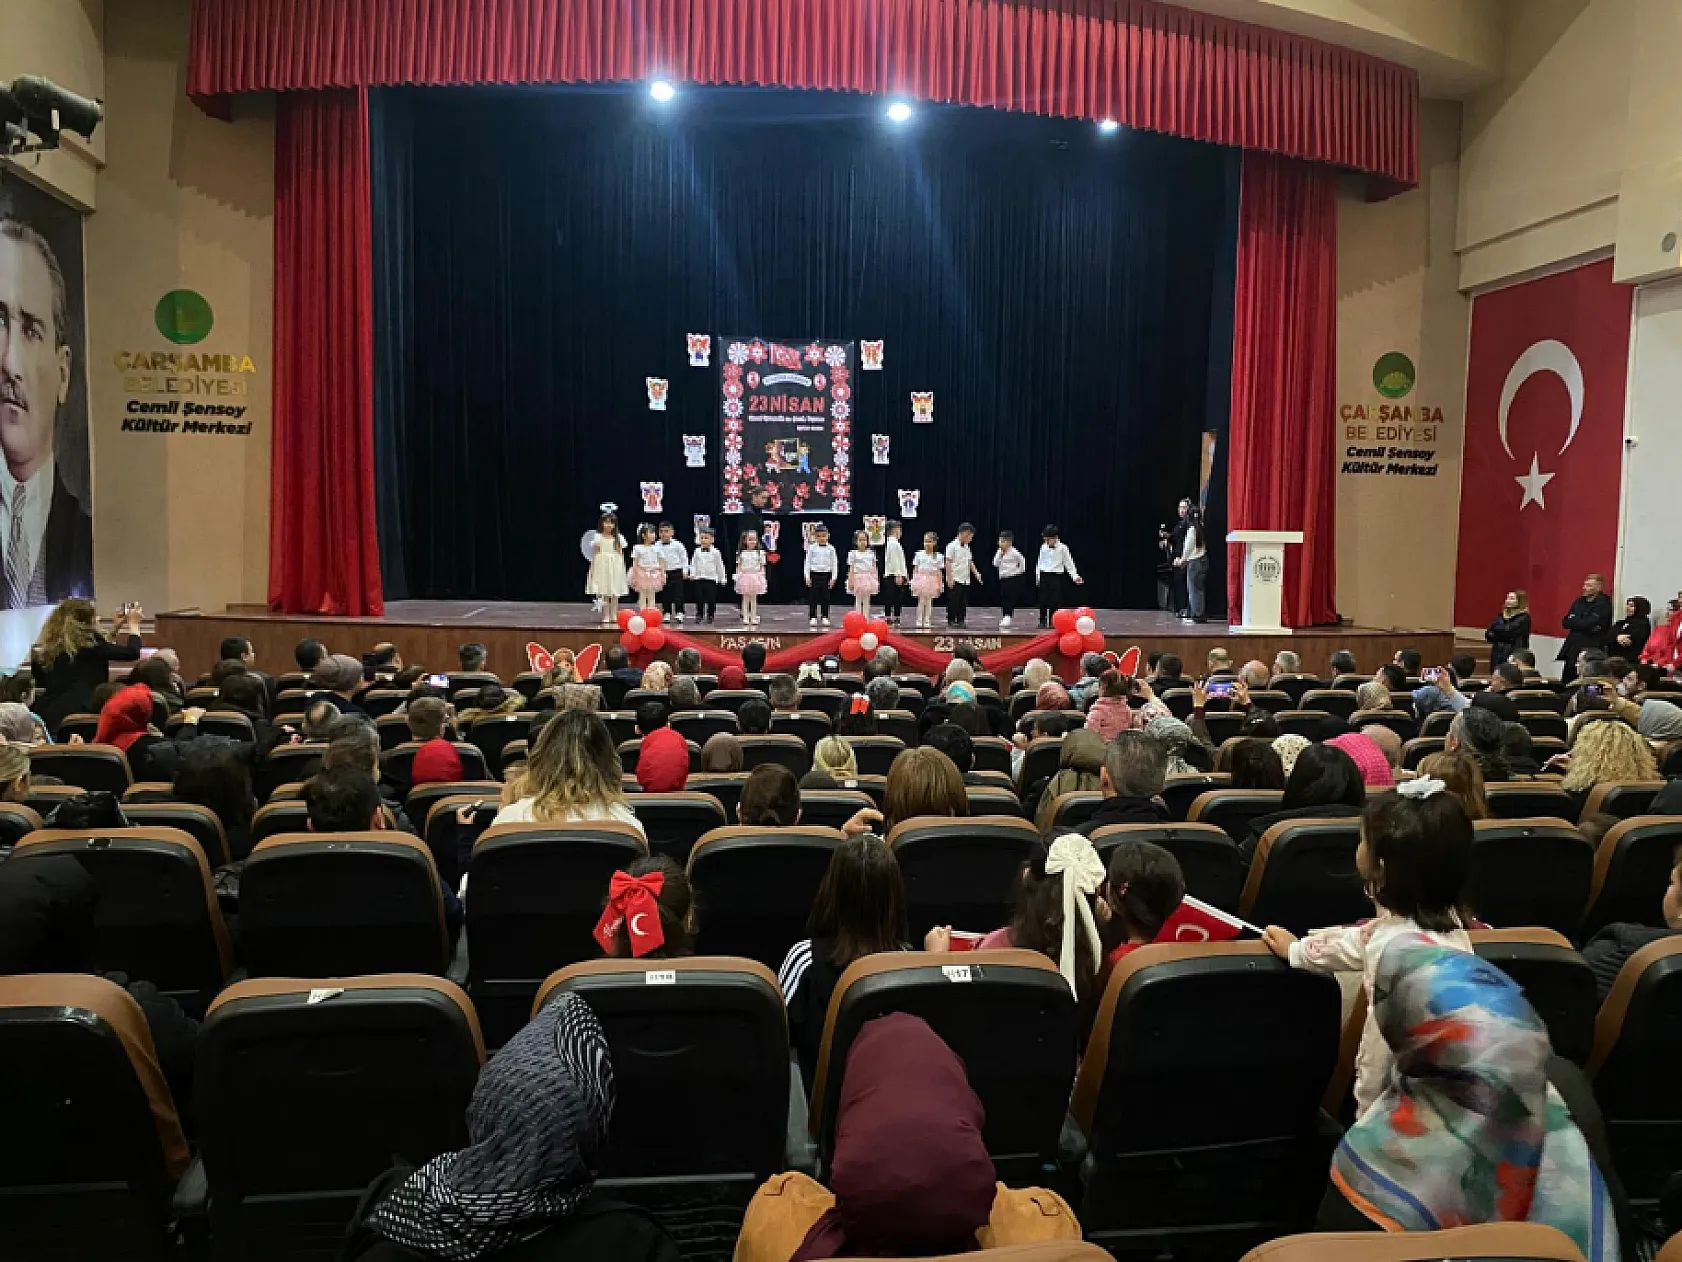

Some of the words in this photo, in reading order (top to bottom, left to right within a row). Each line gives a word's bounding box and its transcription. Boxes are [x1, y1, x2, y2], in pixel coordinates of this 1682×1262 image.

[114, 351, 257, 375] ÇARŞAMBA
[123, 374, 248, 396] BELEDİYESİ
[126, 399, 180, 415] Cemil
[181, 400, 247, 418] Şensoy
[748, 395, 768, 411] 23
[770, 393, 825, 413] NİSAN
[121, 418, 180, 433] Kültür
[181, 420, 253, 435] Merkezi
[1346, 446, 1387, 458] Cemil
[1387, 446, 1436, 462] Şensoy
[1341, 461, 1385, 474] Kültür
[1385, 463, 1440, 476] Merkezi
[933, 636, 954, 652] 23
